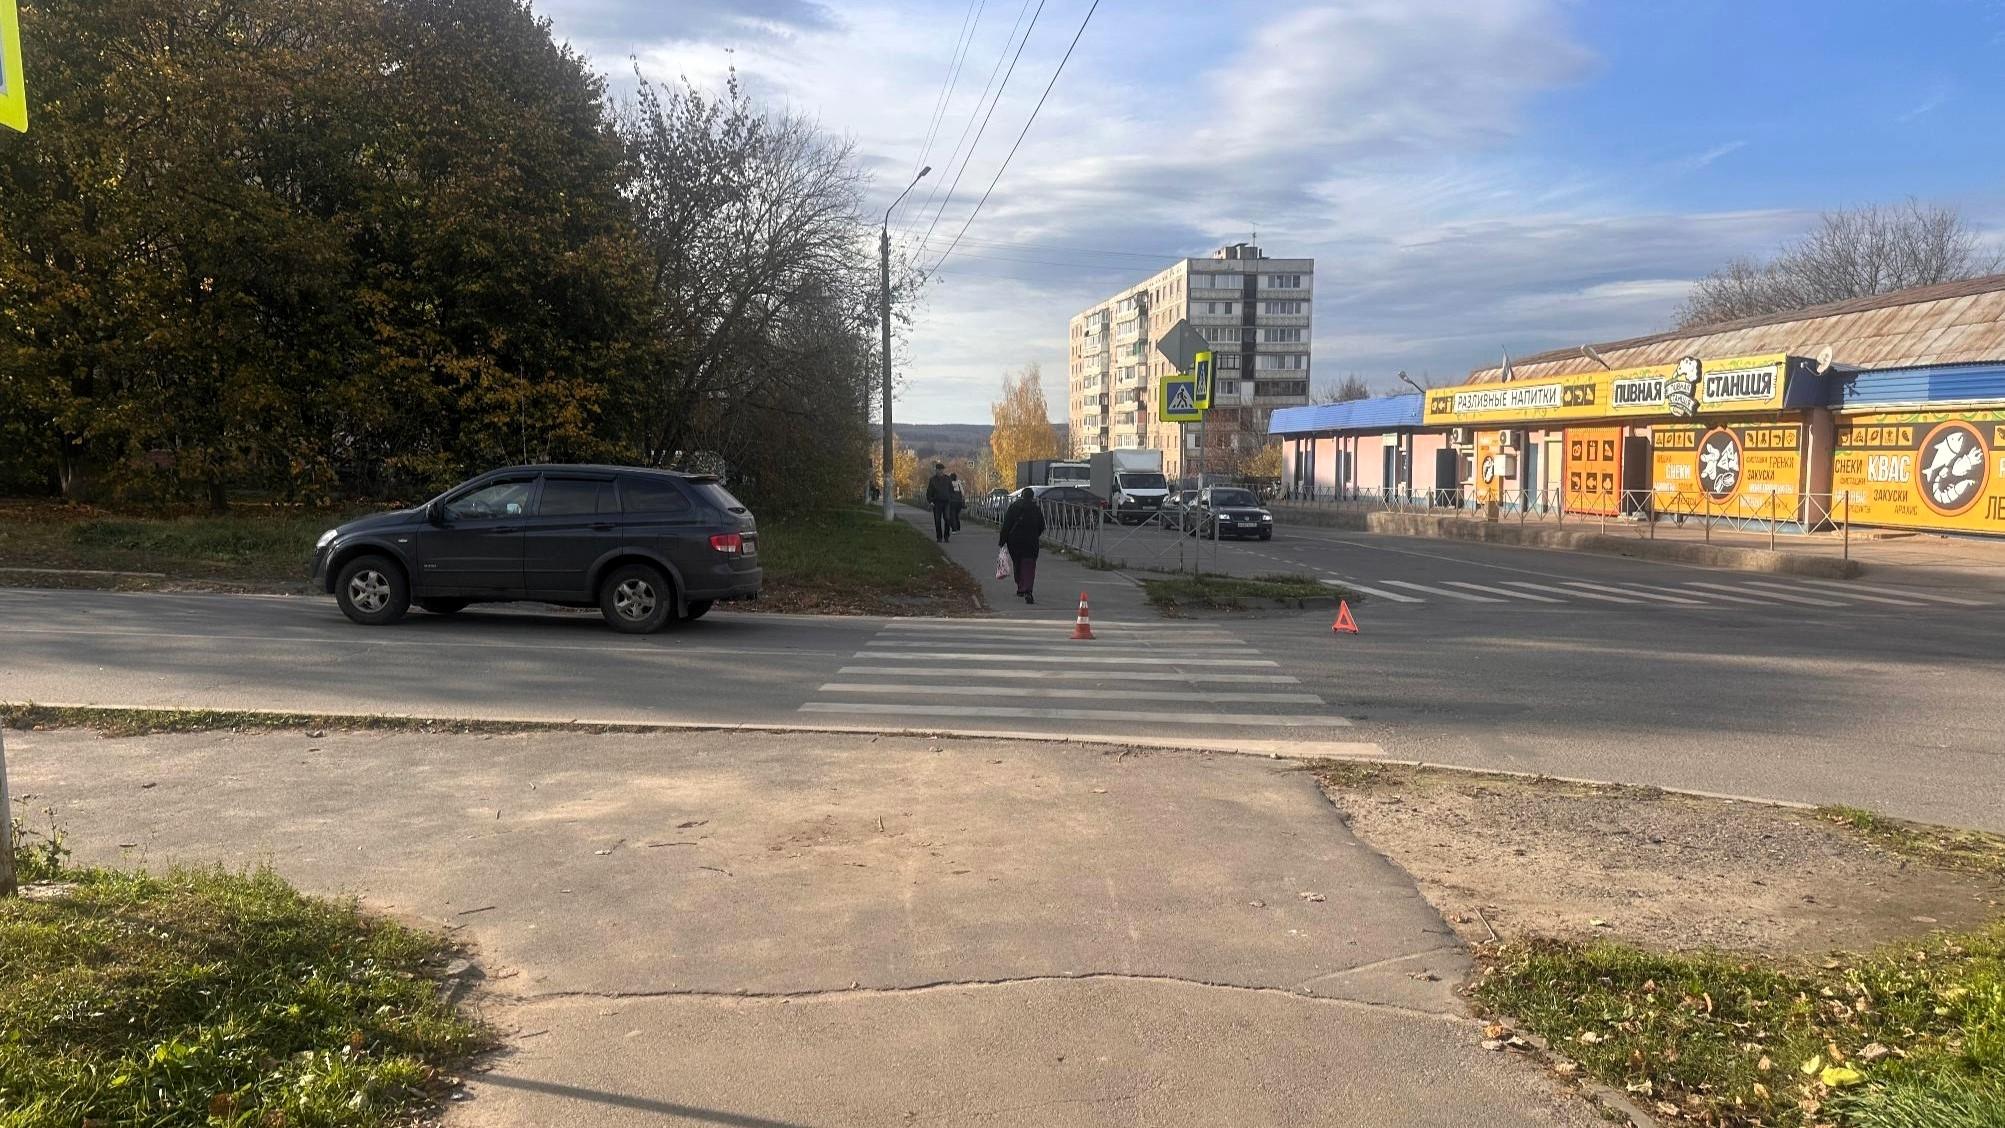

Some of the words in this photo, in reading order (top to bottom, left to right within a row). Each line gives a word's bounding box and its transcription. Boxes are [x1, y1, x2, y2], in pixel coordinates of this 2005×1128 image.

[1614, 381, 1663, 403] ПИВНАЯ
[1706, 372, 1772, 398] СТАНЦИЯ
[1457, 392, 1507, 410] РАЗЛИВНЫЕ
[1511, 387, 1557, 406] НАПИТКИ
[1769, 456, 1794, 469] ГРЕНКИ
[1835, 459, 1863, 475] СНЕКИ
[1867, 454, 1911, 483] КВАС
[1665, 464, 1691, 480] СНЕКИ
[1747, 469, 1775, 481] ЗАКУСКИ
[1873, 489, 1908, 503] ЗАКУСКИ
